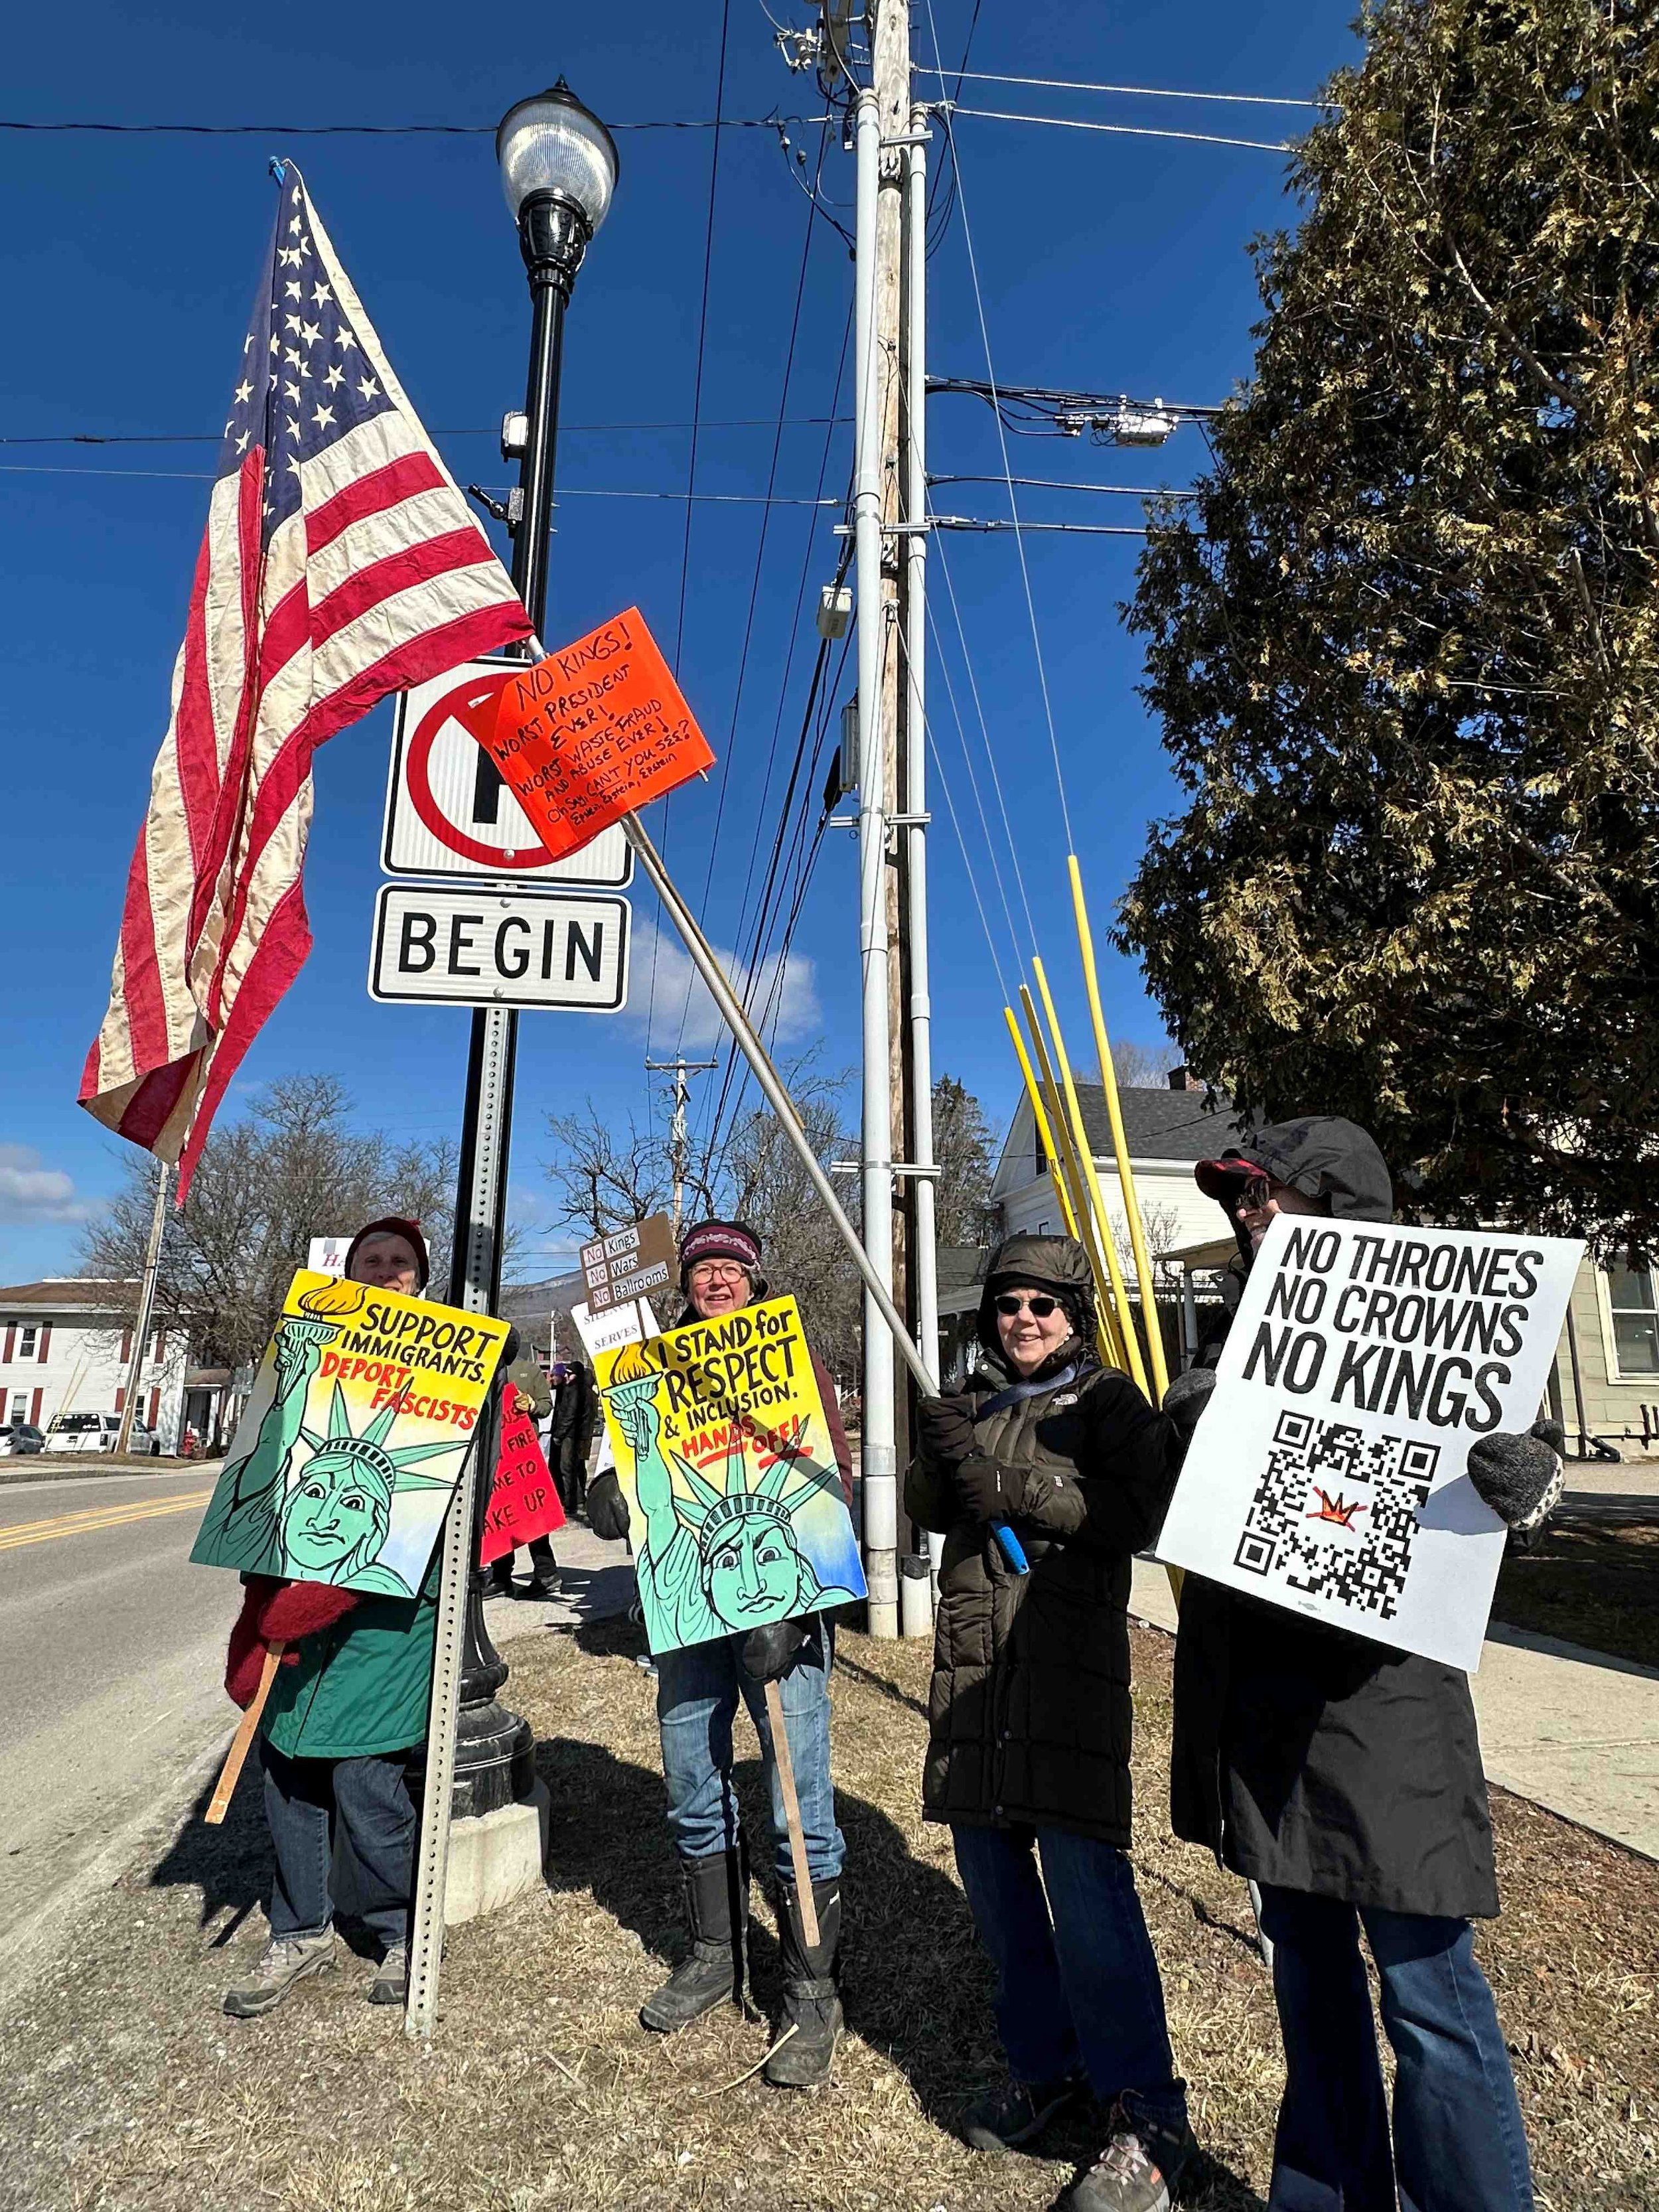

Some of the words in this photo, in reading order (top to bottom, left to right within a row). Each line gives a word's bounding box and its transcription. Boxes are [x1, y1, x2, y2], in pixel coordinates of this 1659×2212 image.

[516, 669, 553, 711] NO
[557, 623, 632, 681] KINGS!
[493, 717, 544, 761] WORST
[544, 664, 630, 723] PRESIDENT
[655, 719, 690, 751] SEE?
[515, 758, 563, 796] WORST
[564, 727, 615, 763] WASTE
[614, 700, 662, 732] FRAUD
[544, 778, 569, 802] AND
[570, 749, 613, 780] ABUSE
[398, 912, 603, 982] BEGIN
[587, 1248, 602, 1262] No
[608, 1232, 635, 1254] Kings
[591, 1269, 605, 1284] No
[612, 1256, 638, 1276] Wars
[1280, 1228, 1341, 1274] NO
[1348, 1234, 1544, 1299] THRONES
[594, 1290, 609, 1304] No
[614, 1269, 668, 1299] Ballrooms
[360, 1303, 499, 1359] SUPPORT
[595, 1325, 638, 1349] SERVES
[658, 1343, 668, 1368] I
[675, 1317, 753, 1363] STAND
[755, 1309, 793, 1339] for
[1265, 1272, 1328, 1325] NO
[1334, 1285, 1528, 1357] CROWNS
[320, 1353, 411, 1388] DEPORT
[341, 1330, 486, 1384] IMMIGRANTS.
[664, 1335, 797, 1413] RESPECT
[1242, 1321, 1327, 1394] NO
[1331, 1341, 1511, 1432] KINGS
[370, 1389, 478, 1430] FASCISTS
[664, 1415, 680, 1439] &
[686, 1381, 798, 1431] INCLUSION.
[752, 1414, 800, 1453] OFF!
[507, 1429, 535, 1452] FIRE
[682, 1415, 757, 1458] HANDS
[516, 1460, 536, 1479] TO
[483, 1505, 520, 1536] AKE
[524, 1488, 545, 1512] UP
